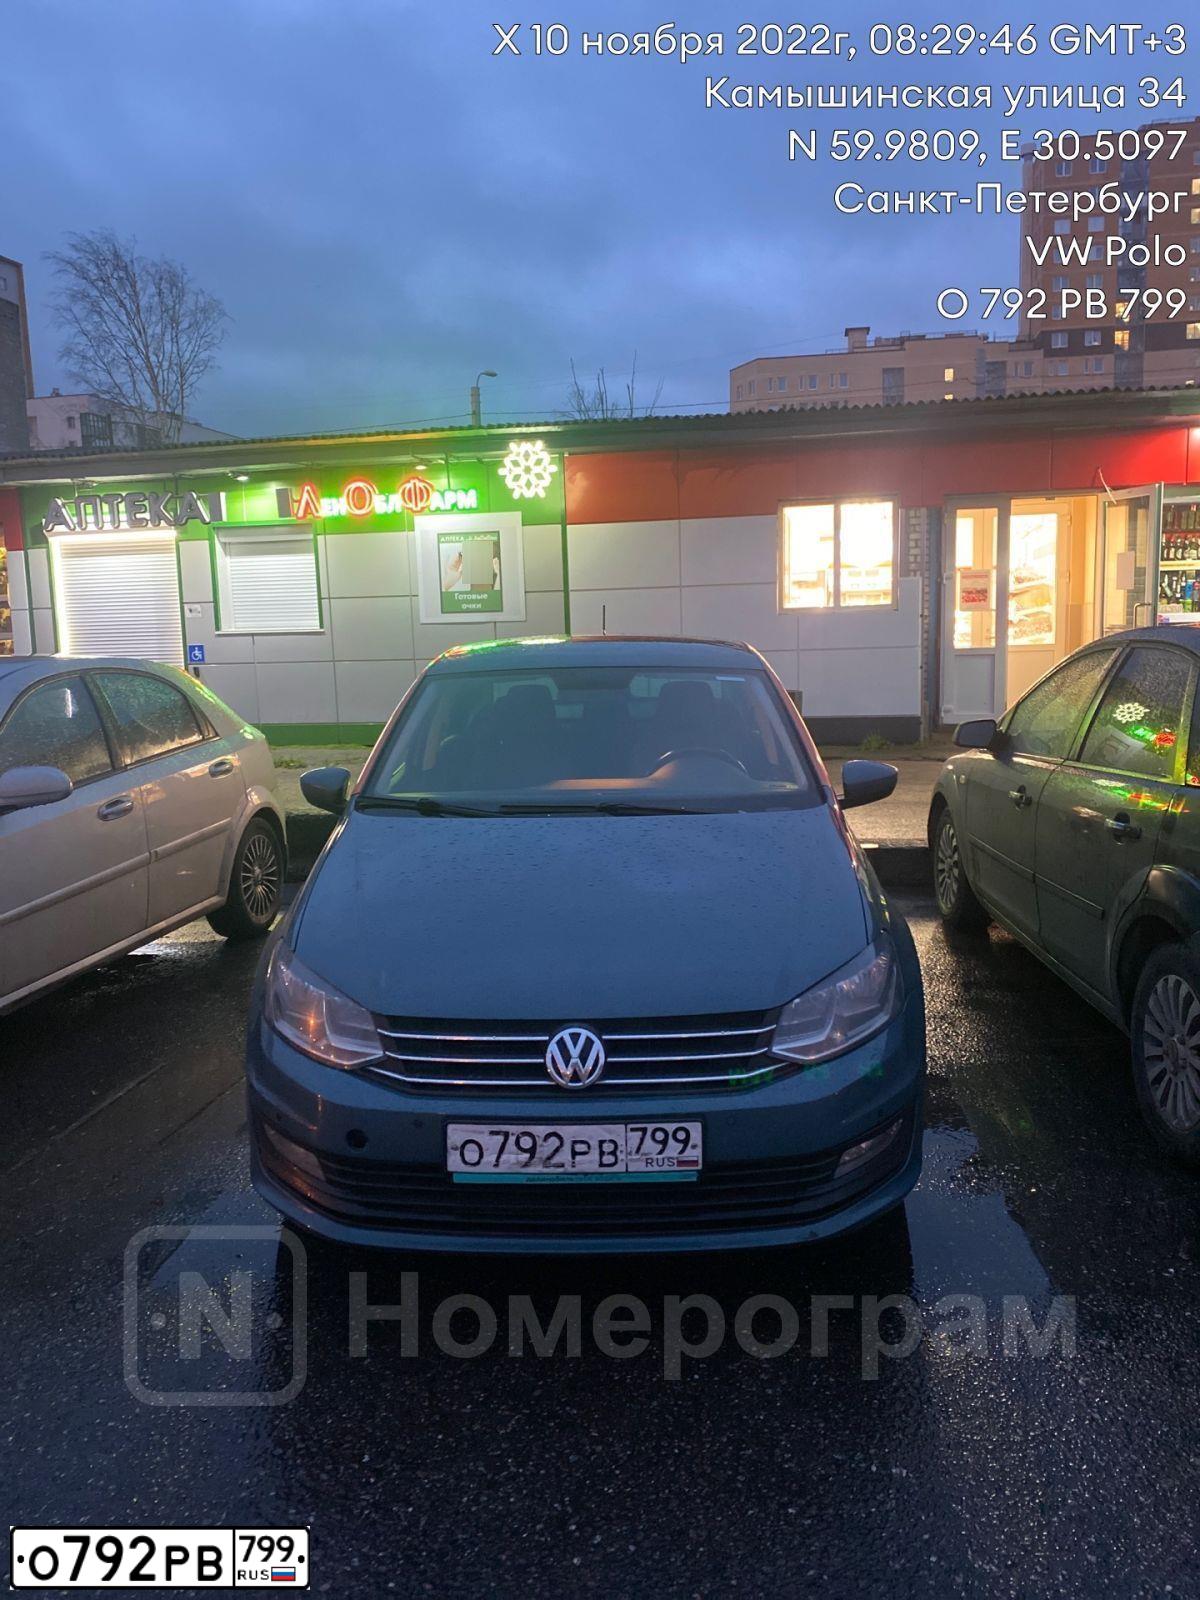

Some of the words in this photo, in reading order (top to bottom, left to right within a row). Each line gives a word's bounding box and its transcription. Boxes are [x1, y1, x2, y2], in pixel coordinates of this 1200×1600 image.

[43, 490, 211, 532] АПТЕКА
[454, 592, 489, 601] Готовые
[546, 1027, 605, 1088] VW
[629, 1126, 692, 1156] 799
[645, 1156, 676, 1168] RUS
